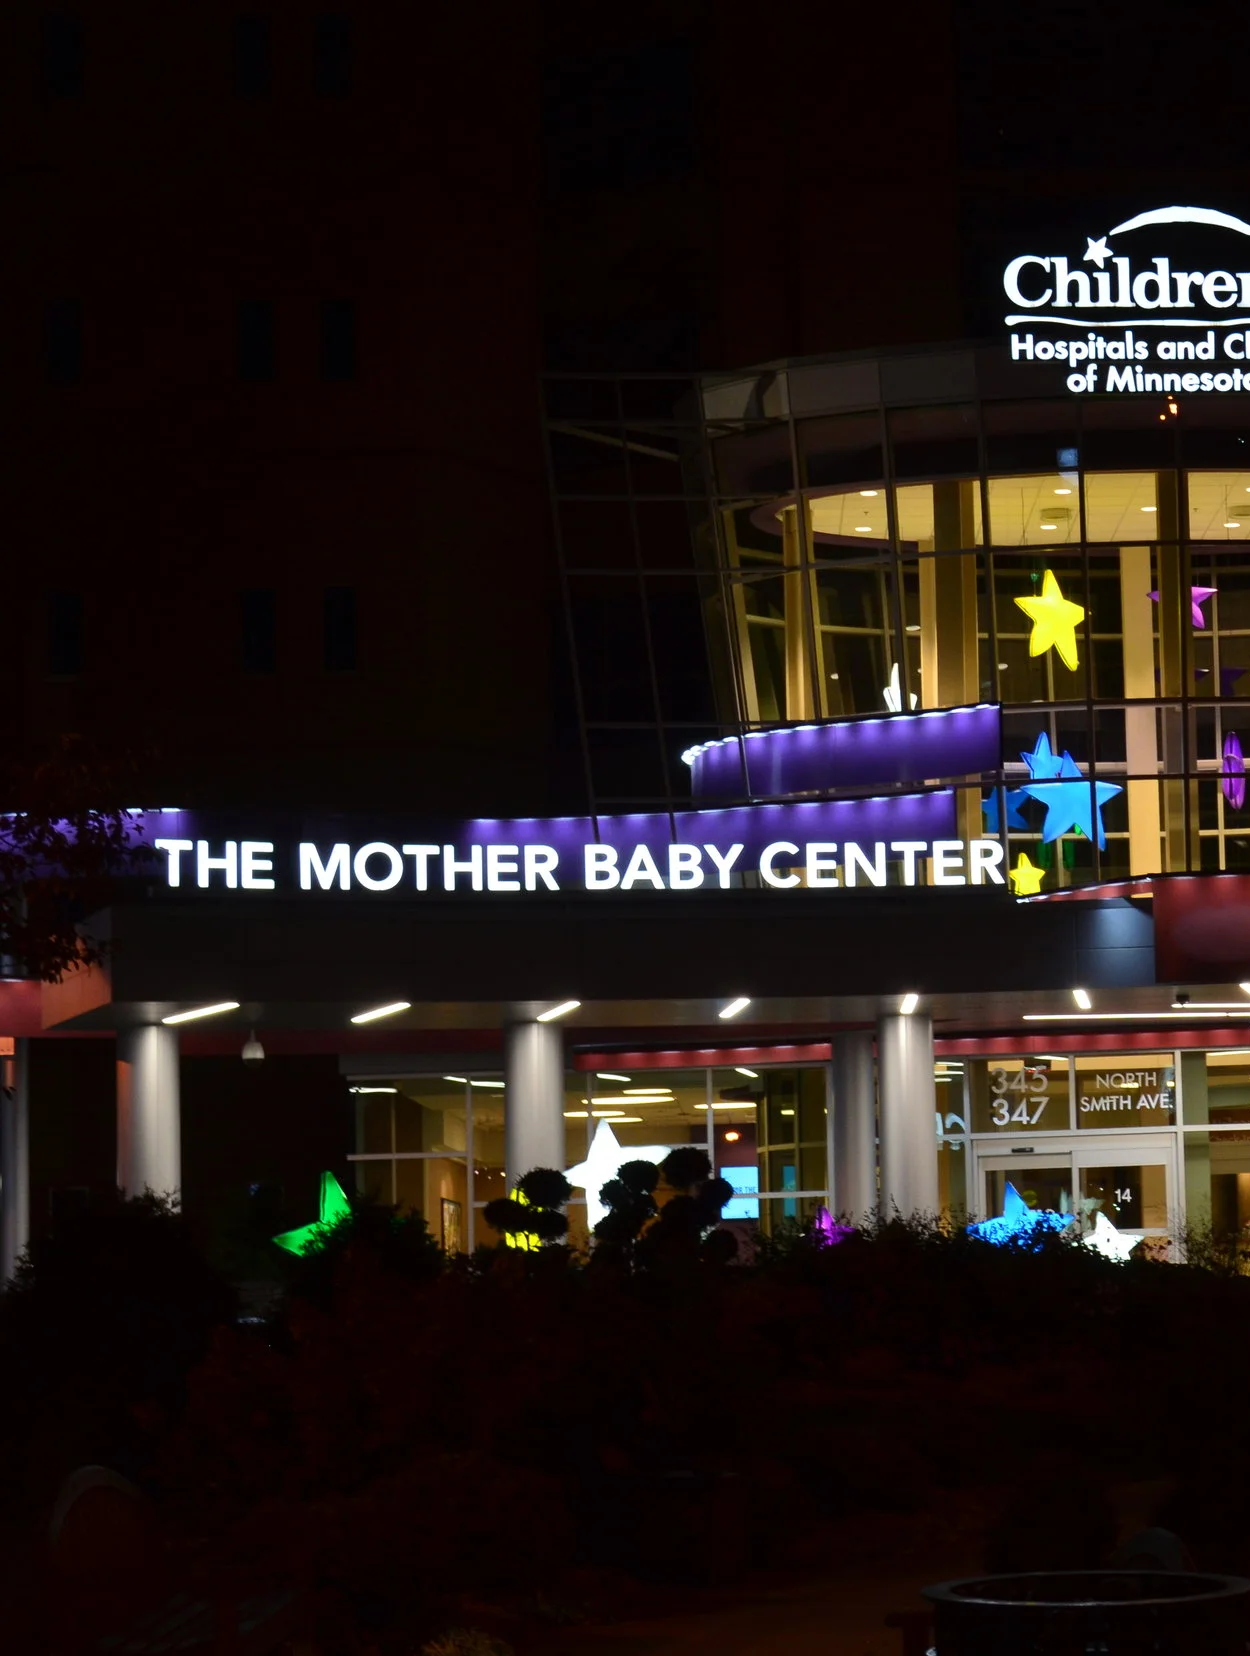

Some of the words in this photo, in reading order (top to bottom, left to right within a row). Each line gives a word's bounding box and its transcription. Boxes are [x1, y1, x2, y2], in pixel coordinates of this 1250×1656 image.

[1011, 331, 1149, 368] Hospitals
[1157, 331, 1216, 360] and
[1066, 363, 1098, 392] of
[155, 838, 275, 890] THE
[300, 841, 560, 892] MOTHER
[584, 843, 745, 890] BABY
[759, 839, 1006, 888] CENTER
[991, 1065, 1049, 1094] 345
[1095, 1072, 1157, 1089] NORTH
[992, 1097, 1050, 1126] 347
[1080, 1096, 1132, 1113] SMITH
[1136, 1094, 1174, 1110] AVE.
[1114, 1188, 1132, 1203] 14
